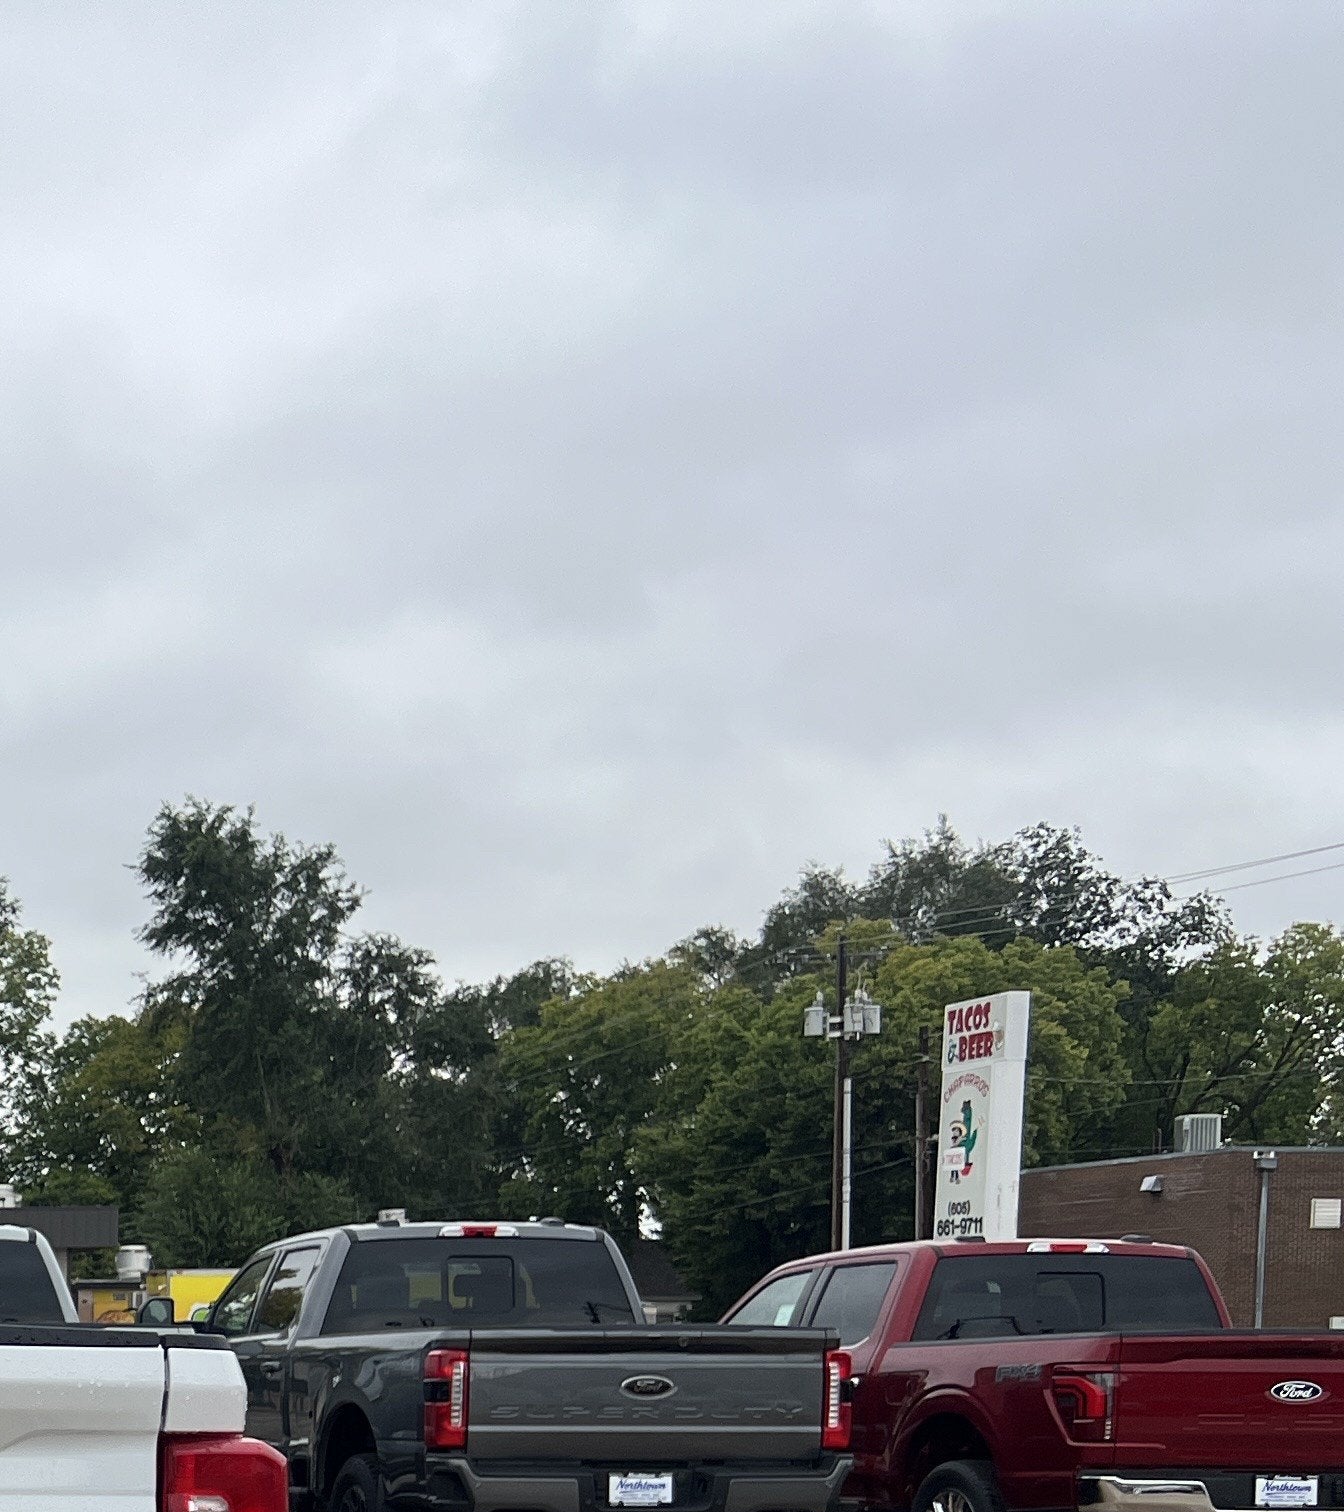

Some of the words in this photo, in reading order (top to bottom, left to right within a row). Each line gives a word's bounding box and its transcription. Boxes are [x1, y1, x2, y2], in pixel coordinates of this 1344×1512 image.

[948, 1002, 991, 1035] TACOS
[959, 1031, 994, 1062] BEER
[948, 1200, 970, 1217] (605)
[937, 1217, 983, 1236] 661-9711
